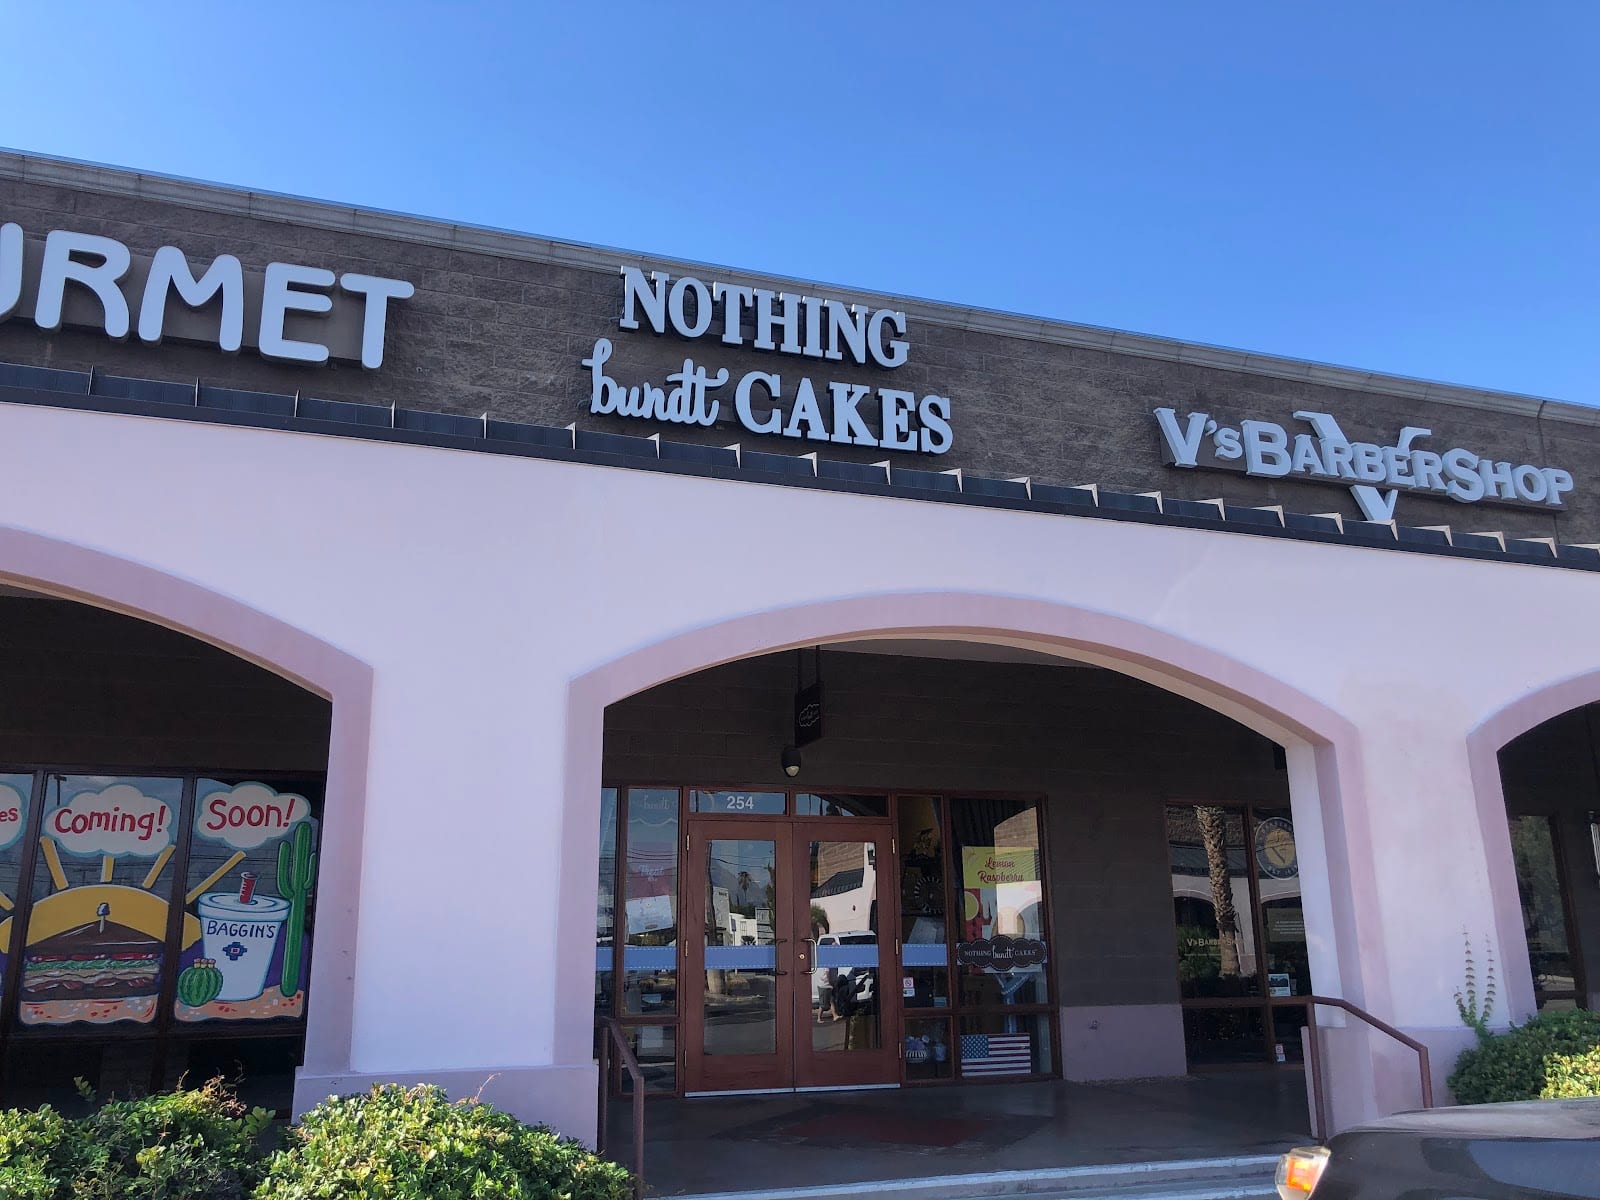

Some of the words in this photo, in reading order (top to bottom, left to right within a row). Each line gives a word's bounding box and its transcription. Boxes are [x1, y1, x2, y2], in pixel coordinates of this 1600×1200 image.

[619, 265, 910, 369] NOTHING
[581, 337, 730, 427] bundt
[734, 371, 954, 455] CAKES
[206, 798, 296, 831] Soon!
[726, 795, 754, 810] 254
[54, 805, 167, 841] Coming!
[206, 920, 276, 939] BAGGIN'S
[964, 949, 992, 958] NOTHING
[992, 945, 1015, 959] bundt
